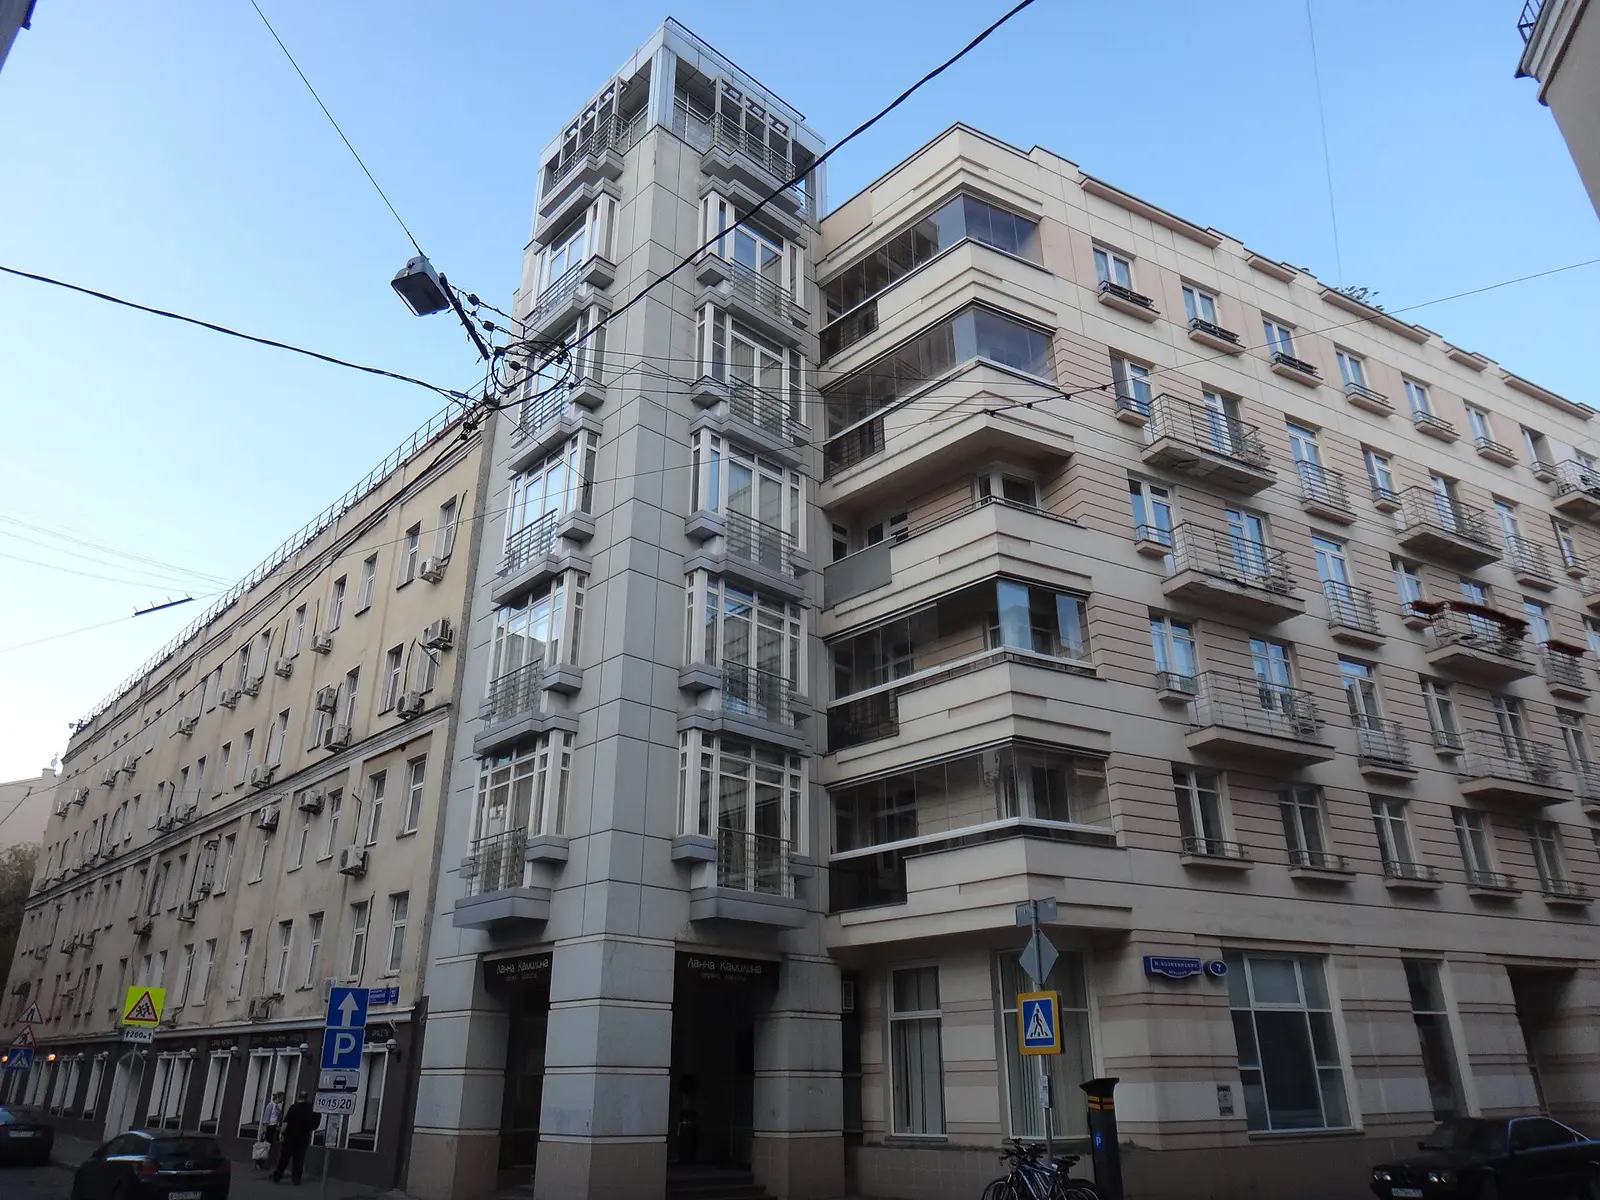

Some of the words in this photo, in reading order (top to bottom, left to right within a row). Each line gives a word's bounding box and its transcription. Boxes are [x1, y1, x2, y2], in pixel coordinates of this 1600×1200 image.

[687, 956, 716, 971] Ланна
[1215, 963, 1222, 973] 7
[333, 1033, 356, 1065] P
[318, 1098, 326, 1106] 10
[328, 1099, 337, 1108] 15
[340, 1098, 352, 1110] 20
[1095, 1136, 1102, 1146] P
